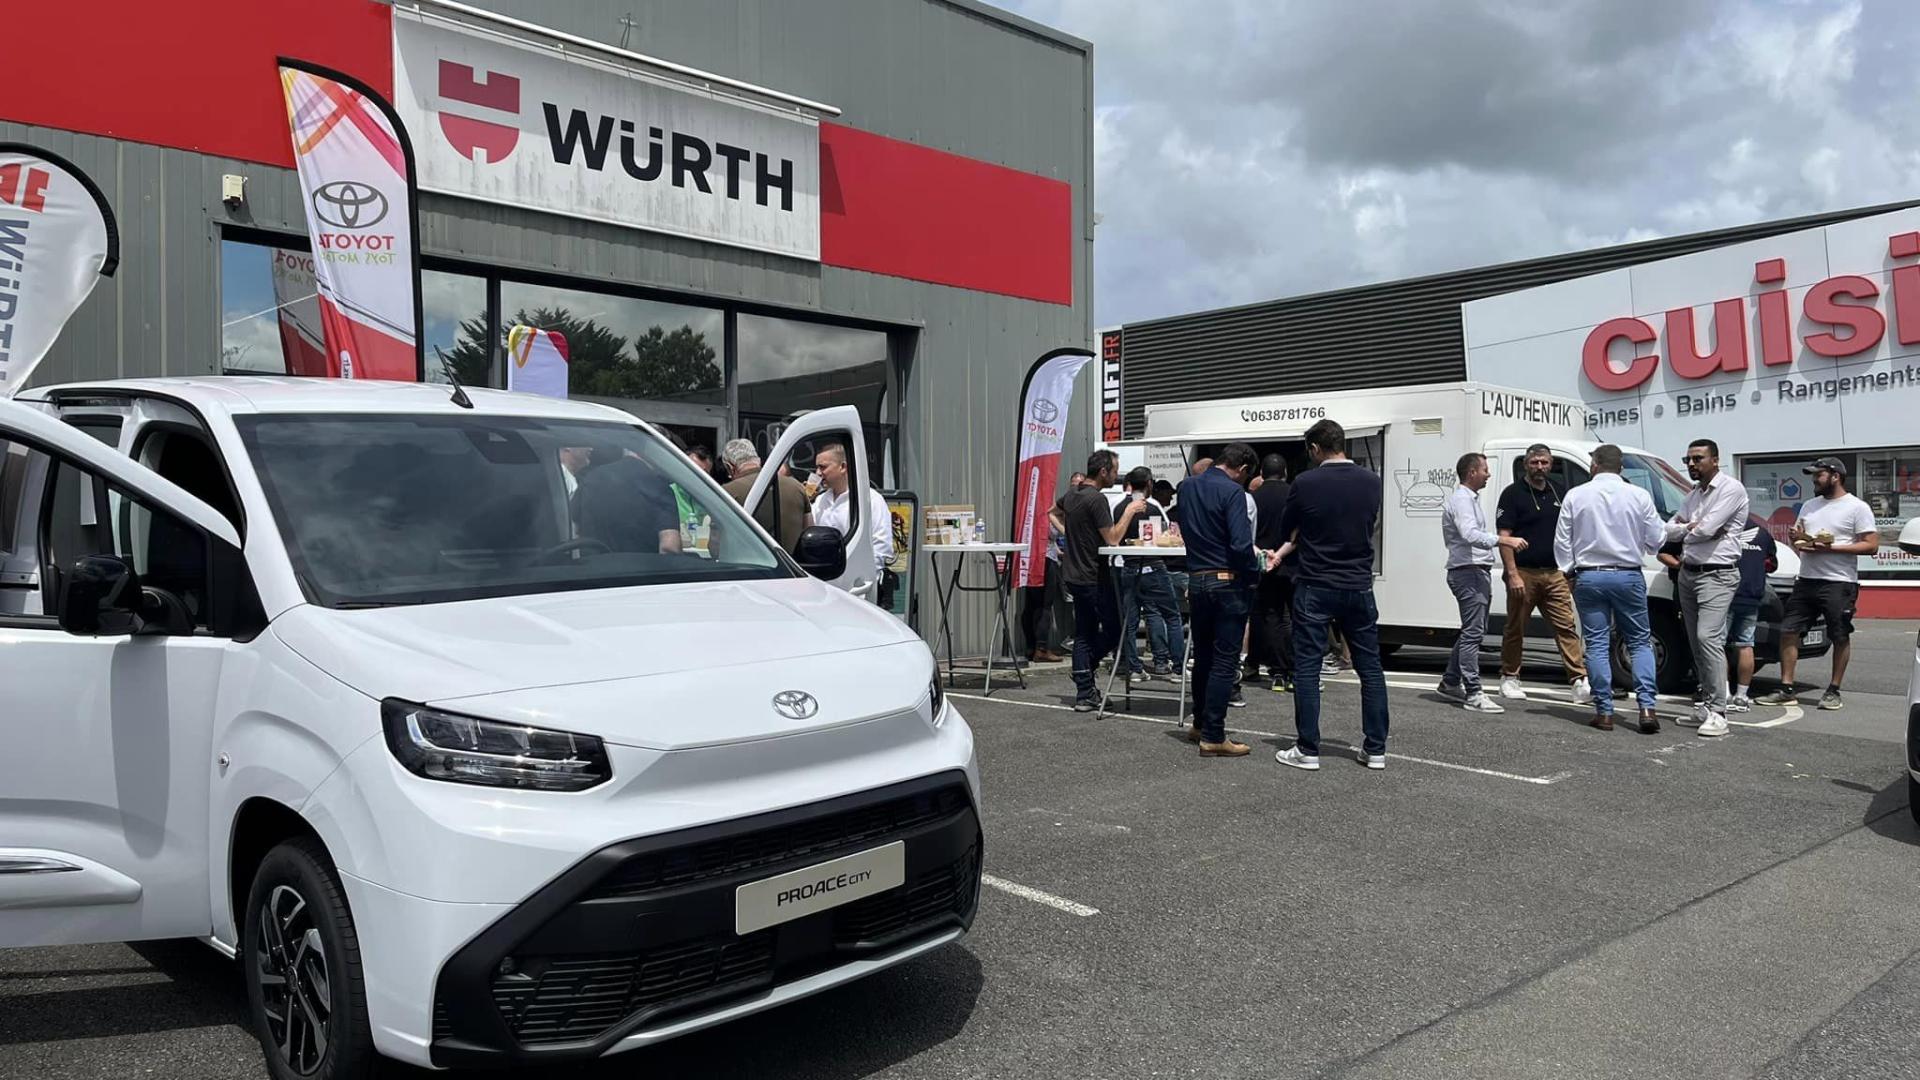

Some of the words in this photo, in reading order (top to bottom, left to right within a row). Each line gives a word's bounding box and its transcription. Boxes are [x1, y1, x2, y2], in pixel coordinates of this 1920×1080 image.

[1582, 231, 1920, 391] cuisi
[1250, 406, 1326, 422] 0638781766
[1481, 390, 1571, 427] L'AUTHENTIK
[1676, 391, 1737, 415] Bains
[1027, 422, 1057, 436] TOYOTA
[777, 873, 847, 907] PROACE
[848, 870, 872, 885] CITY
